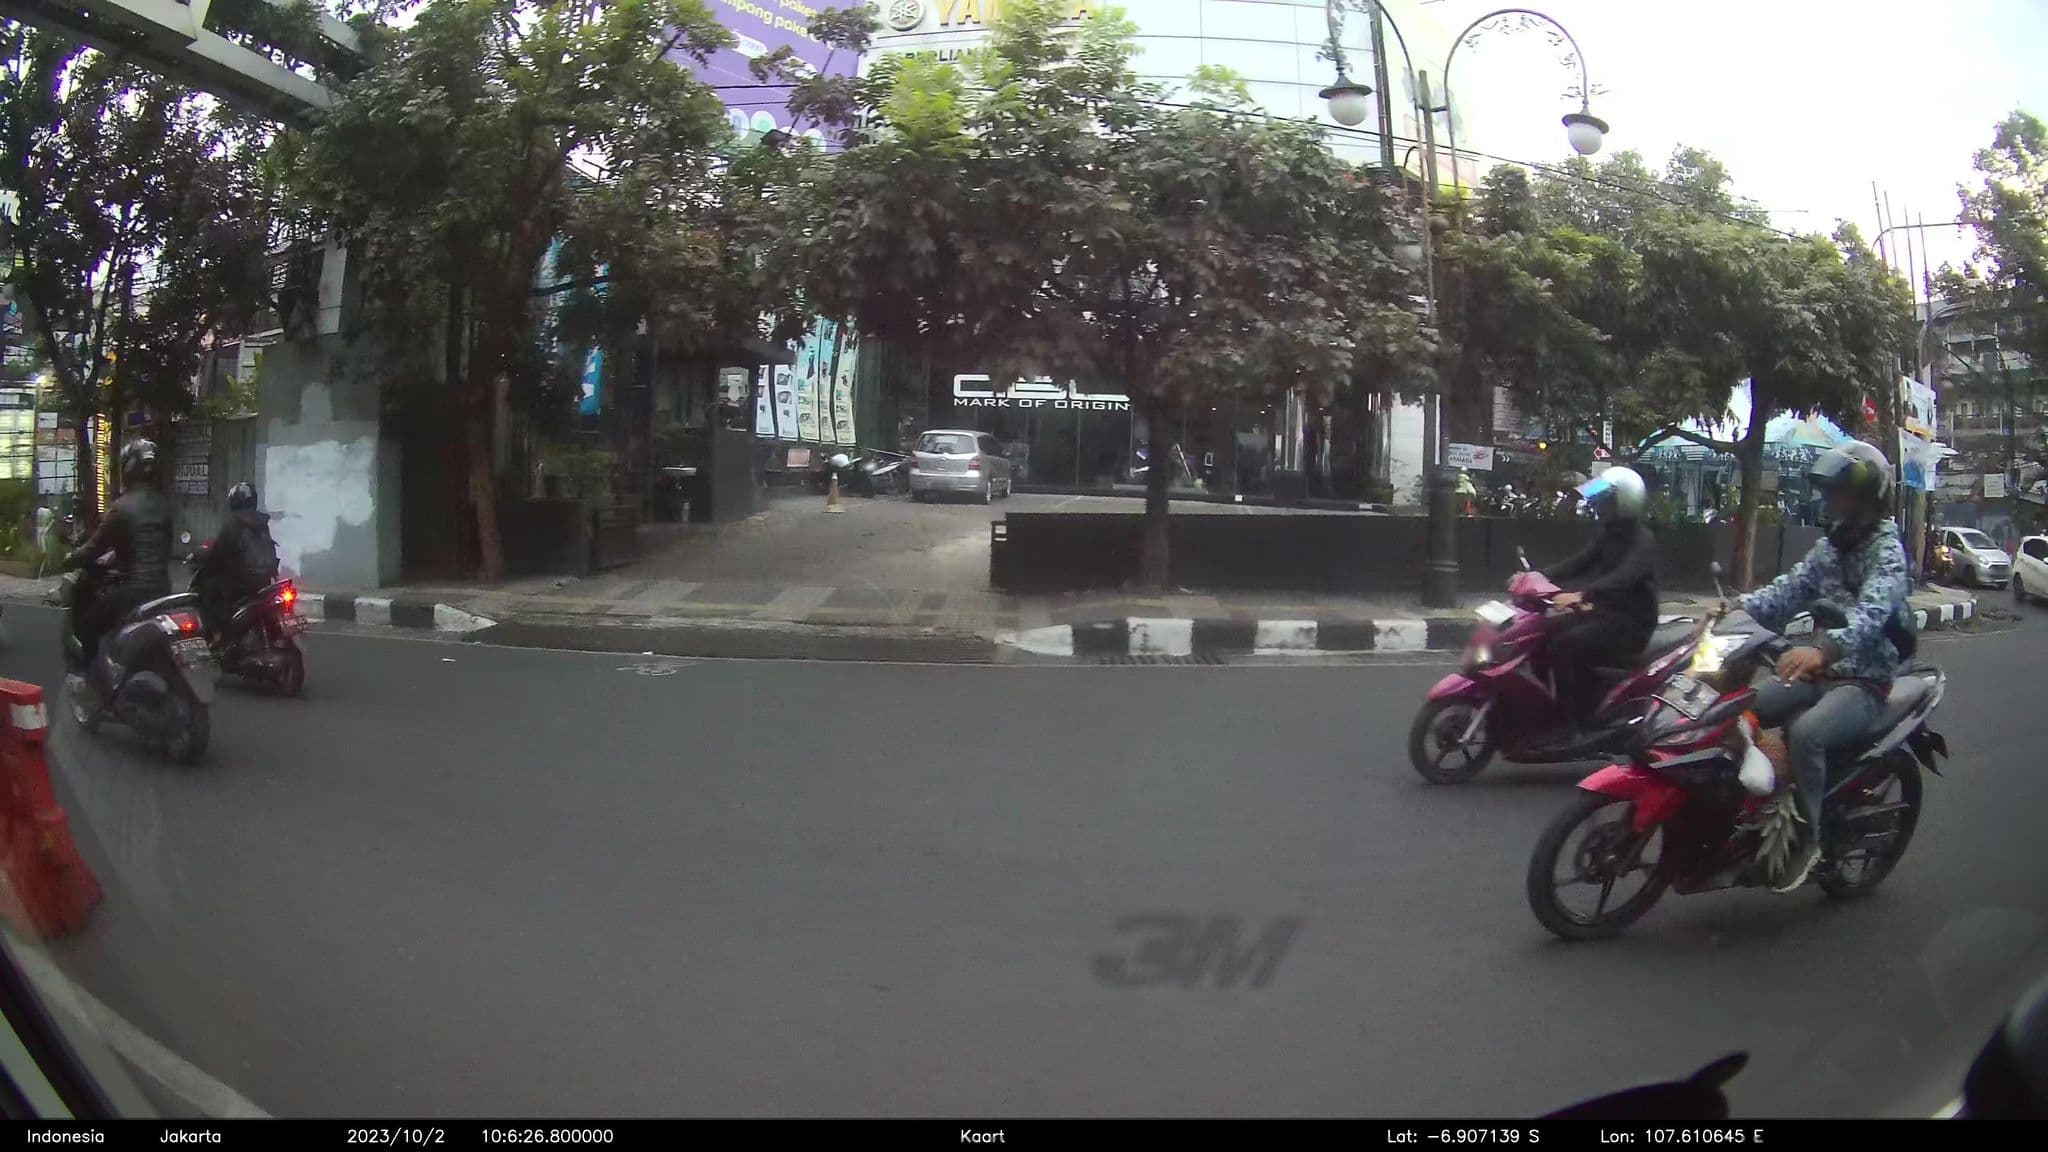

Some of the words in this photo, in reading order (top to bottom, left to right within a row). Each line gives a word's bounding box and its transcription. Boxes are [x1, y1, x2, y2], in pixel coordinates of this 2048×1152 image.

[953, 398, 1010, 407] MARK
[1019, 399, 1046, 408] OF
[1055, 400, 1130, 411] ORIGIN
[1090, 911, 1303, 988] 3M
